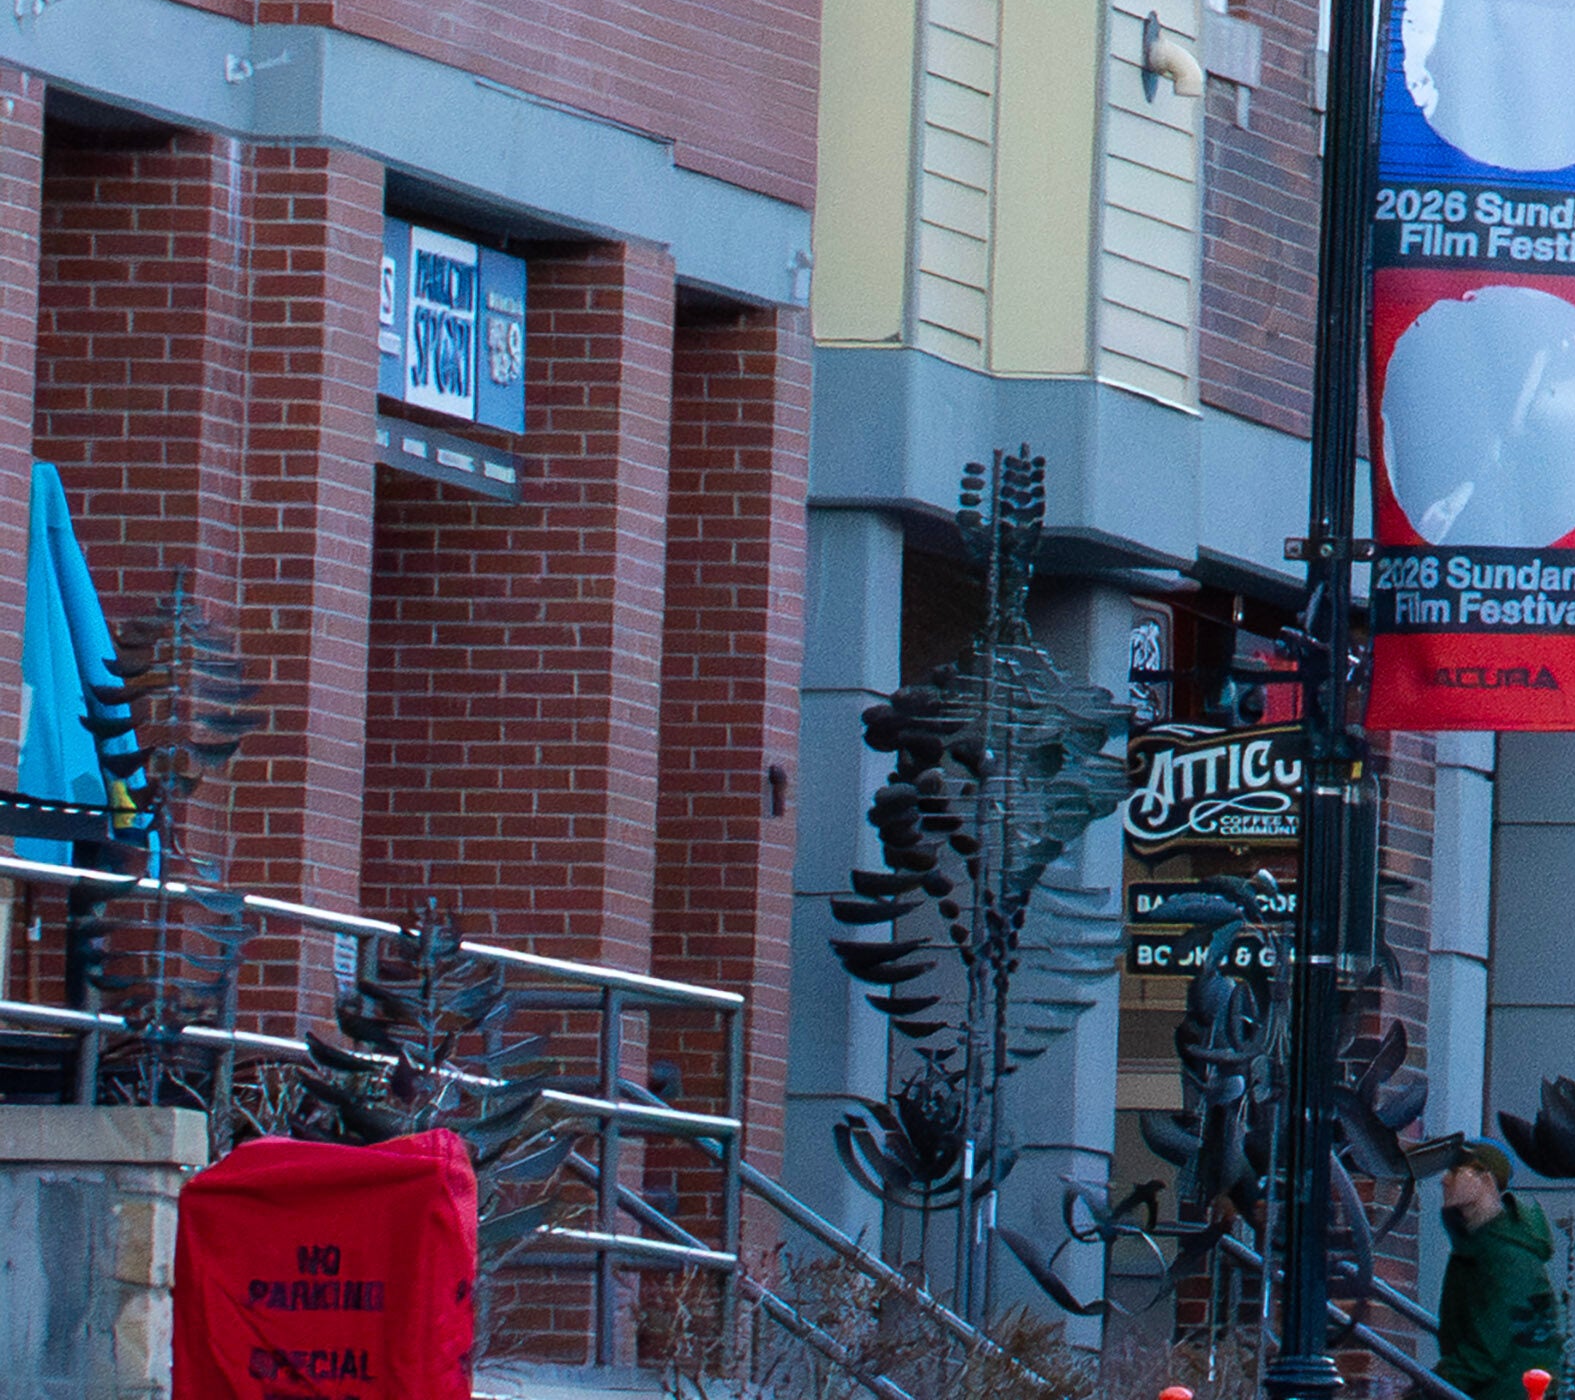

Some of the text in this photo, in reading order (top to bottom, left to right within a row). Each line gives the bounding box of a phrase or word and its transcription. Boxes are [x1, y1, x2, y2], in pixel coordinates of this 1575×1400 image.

[1375, 187, 1468, 222] 2026
[1400, 222, 1479, 257] Film
[1396, 591, 1451, 625] Film
[1430, 666, 1560, 691] ACURA
[297, 1245, 341, 1276] NO
[248, 1279, 385, 1312] PARKING
